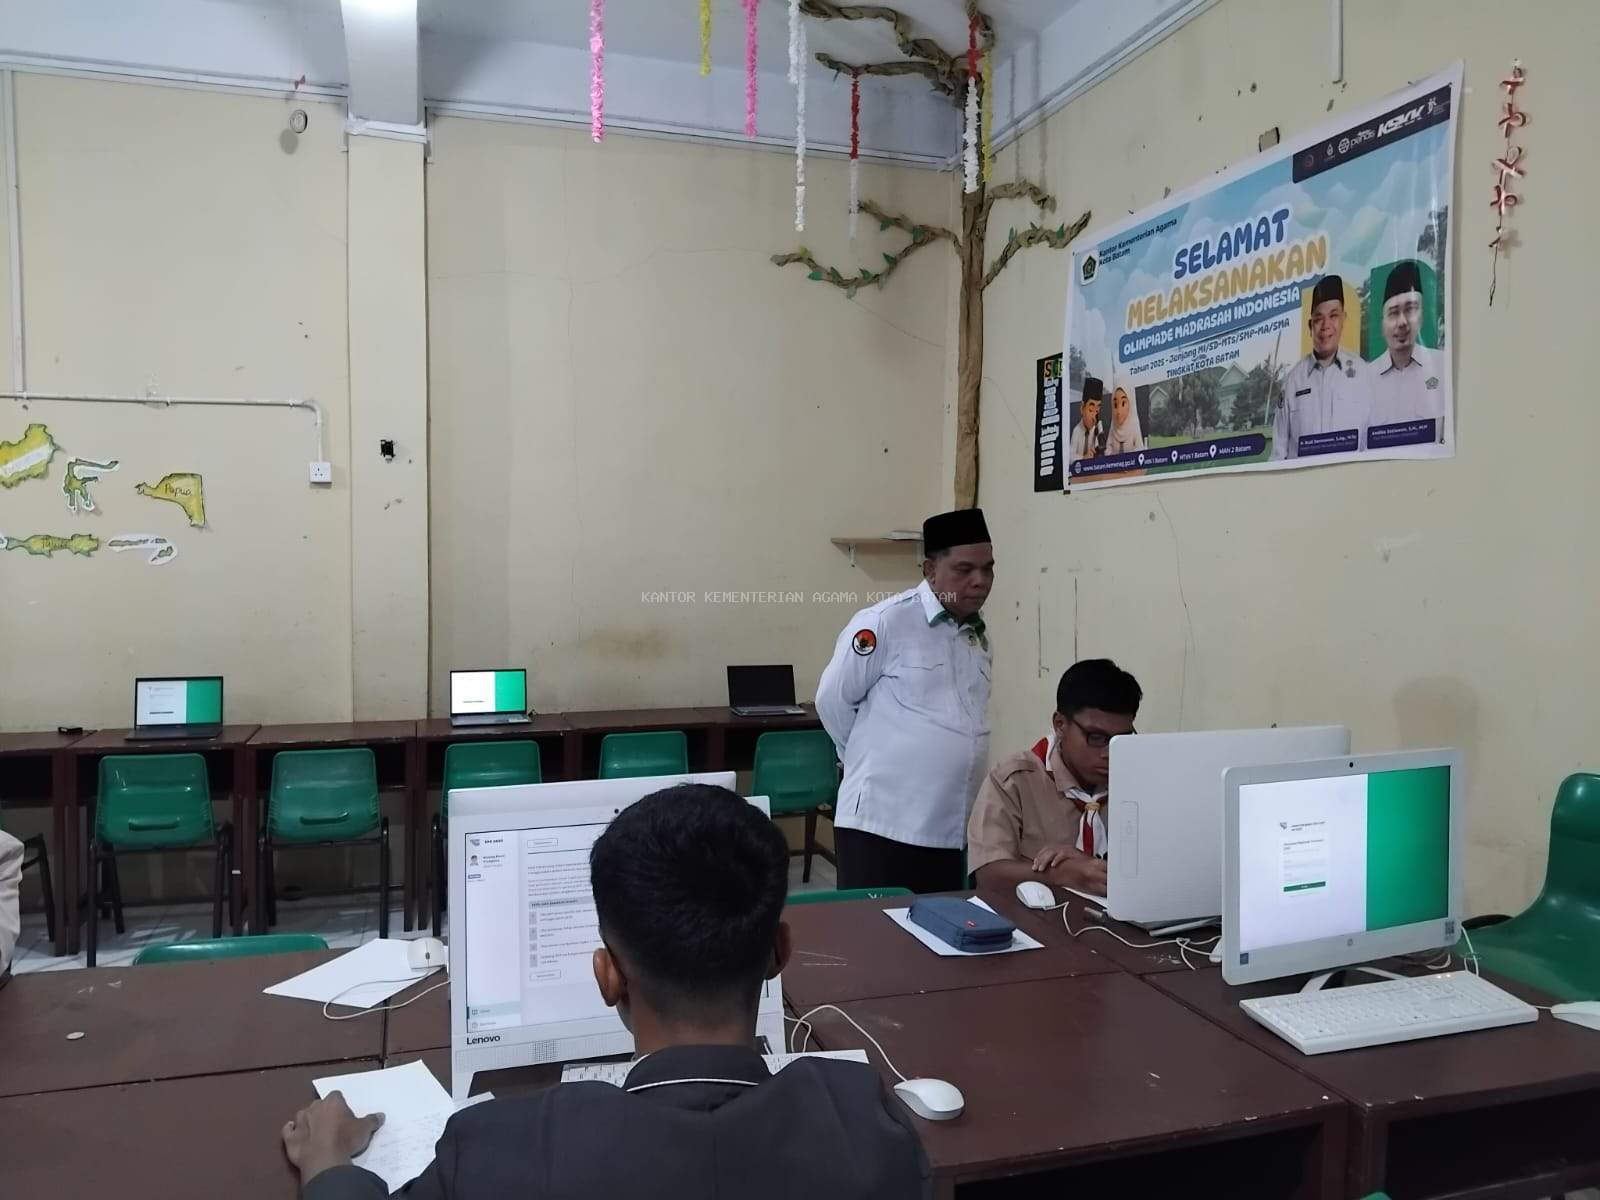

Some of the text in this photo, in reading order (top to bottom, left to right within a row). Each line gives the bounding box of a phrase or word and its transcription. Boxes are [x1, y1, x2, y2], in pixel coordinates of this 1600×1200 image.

[1099, 219, 1178, 258] Kantor Kementerian Agama
[1173, 208, 1290, 280] SELAMAT
[1099, 248, 1131, 266] Kota Batam
[1127, 235, 1327, 329] MELAKSANAKAN
[1123, 286, 1300, 356] OLIMPIADE MADRASAH INDONESIA
[1130, 363, 1150, 376] Tahun
[1150, 358, 1165, 370] 2025
[1168, 349, 1197, 366] Jenjang
[1167, 349, 1240, 378] TINGKAT KOTA BATAM
[1194, 451, 1209, 459] Batam
[1235, 445, 1252, 453] Batam
[466, 1035, 501, 1045] Lenovo
